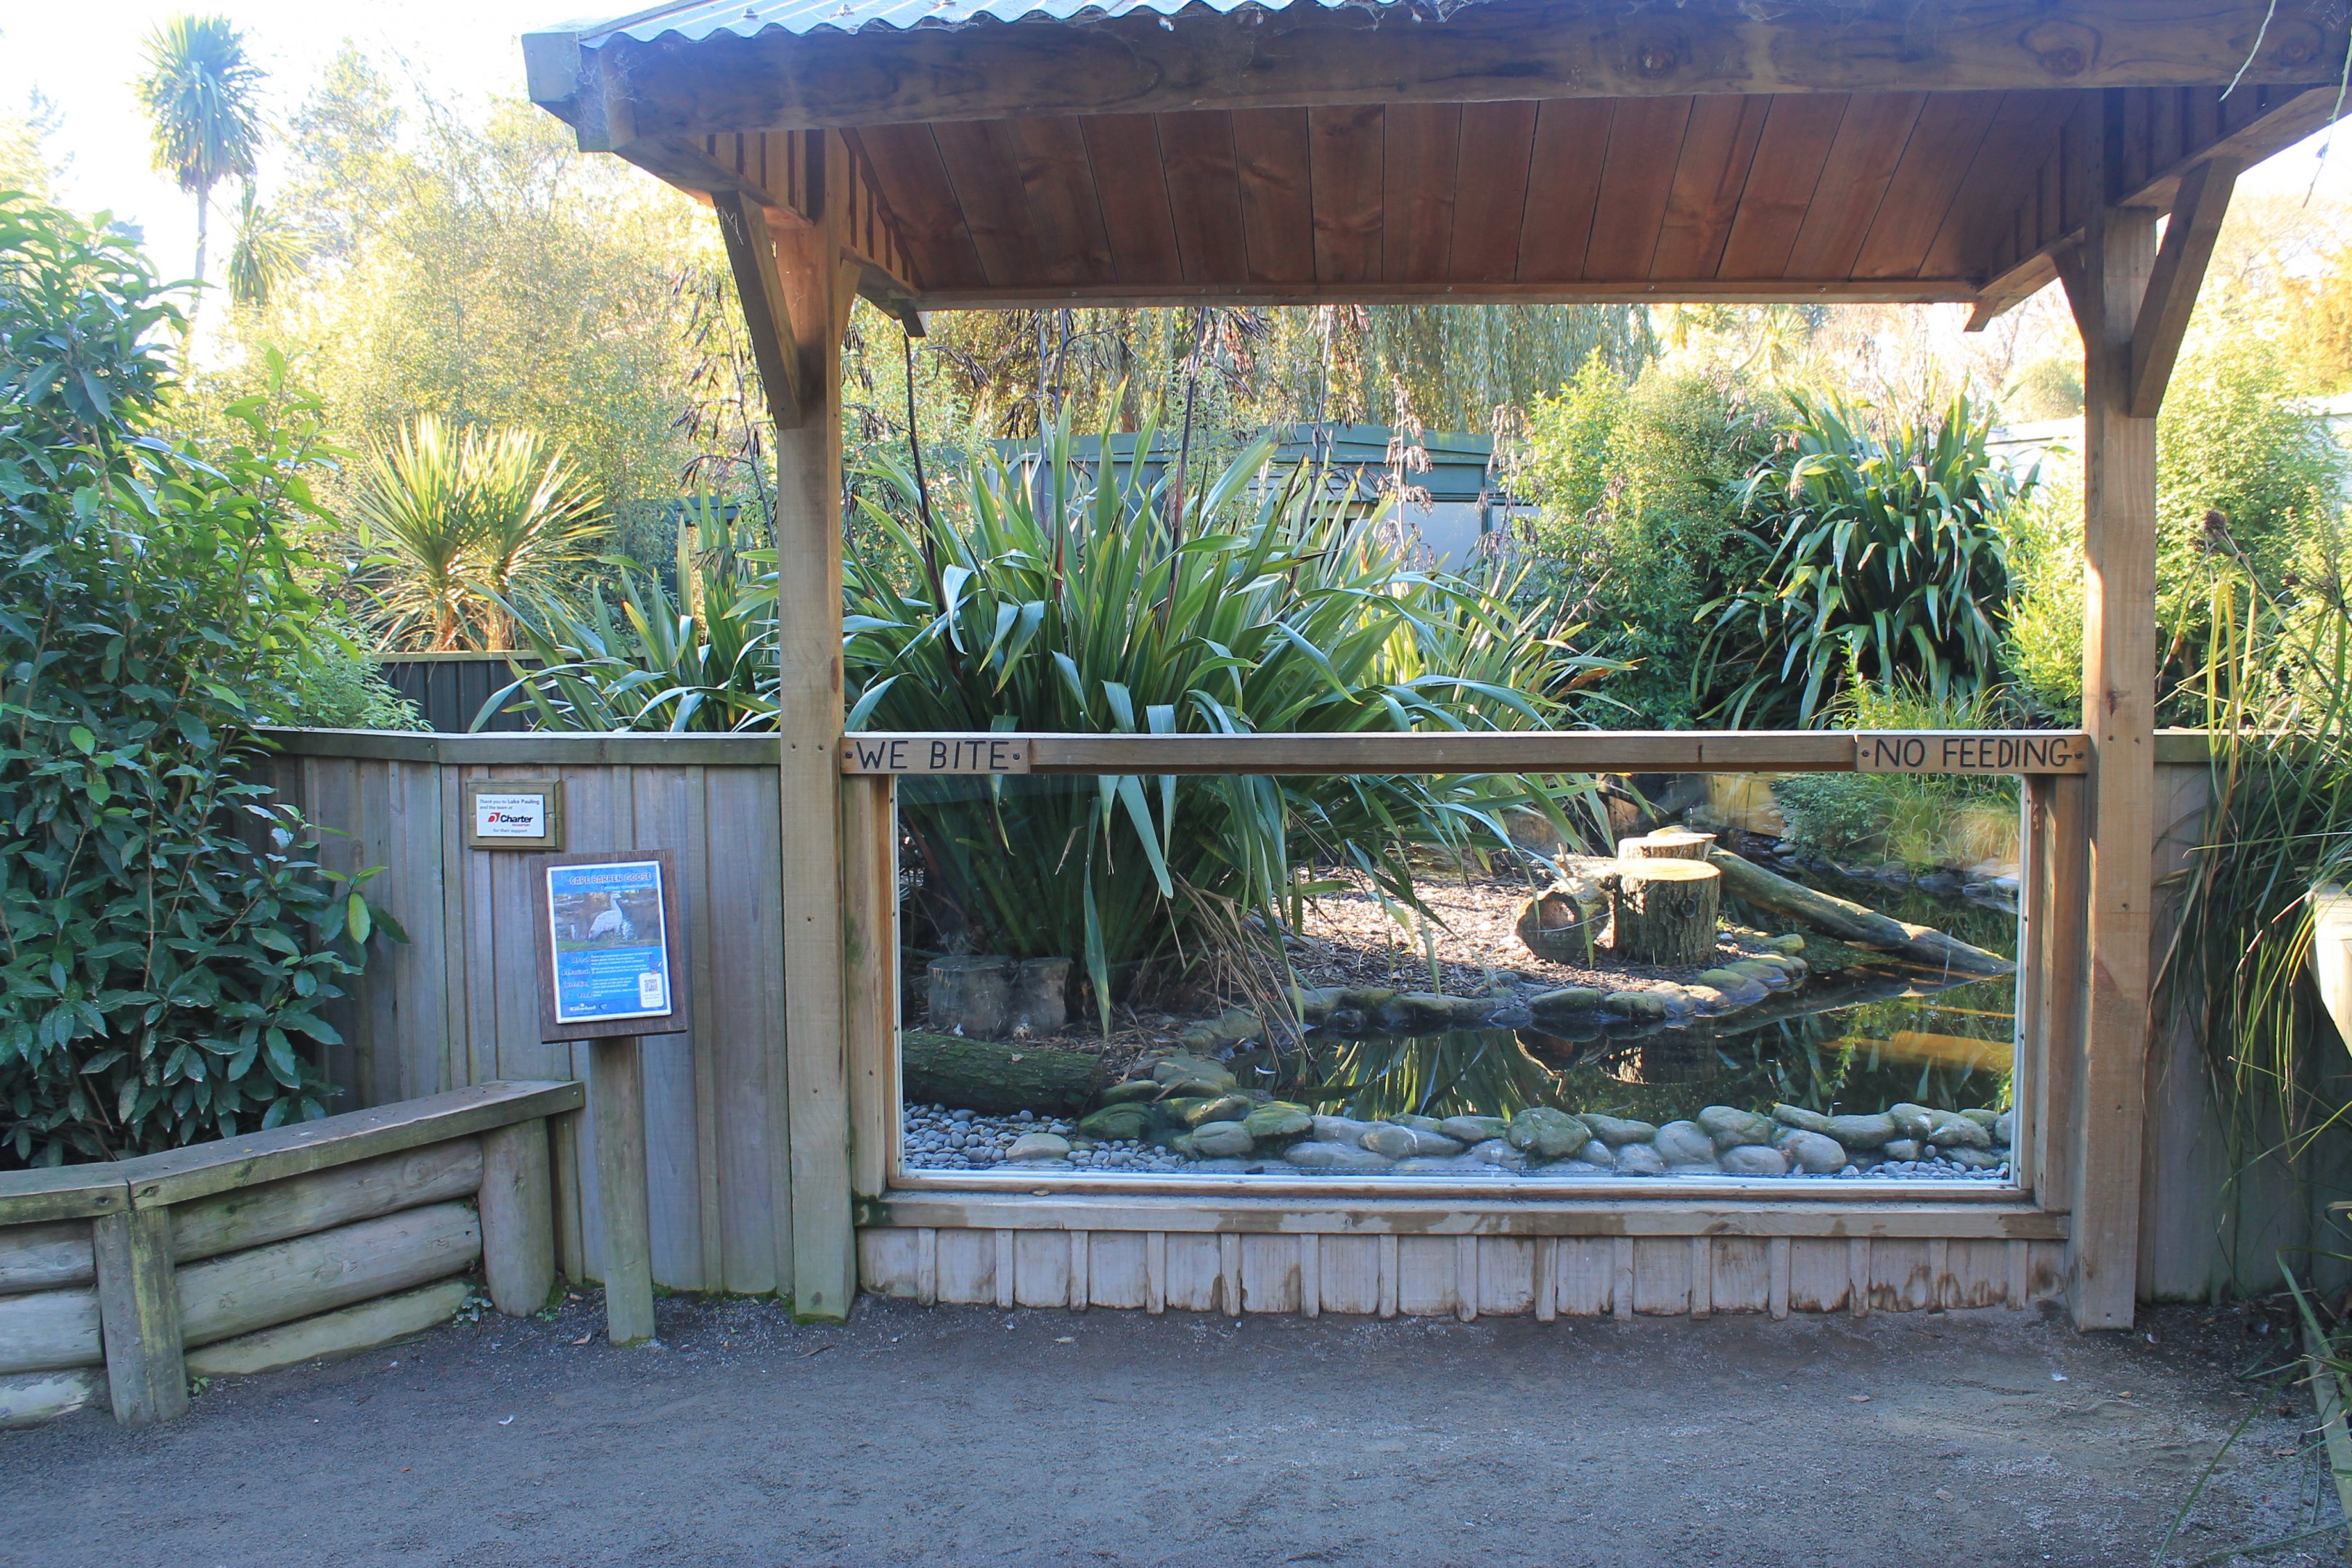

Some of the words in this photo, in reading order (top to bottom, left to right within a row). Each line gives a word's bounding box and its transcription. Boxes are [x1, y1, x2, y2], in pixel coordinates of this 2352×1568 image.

[856, 740, 909, 769] WE
[929, 740, 1010, 770] BITE
[1874, 738, 1925, 767] NO
[1943, 738, 2073, 768] FEEDING
[500, 814, 533, 823] Charter
[570, 876, 590, 885] CAPE
[592, 875, 622, 883] BARREN
[624, 873, 652, 882] GOOSE
